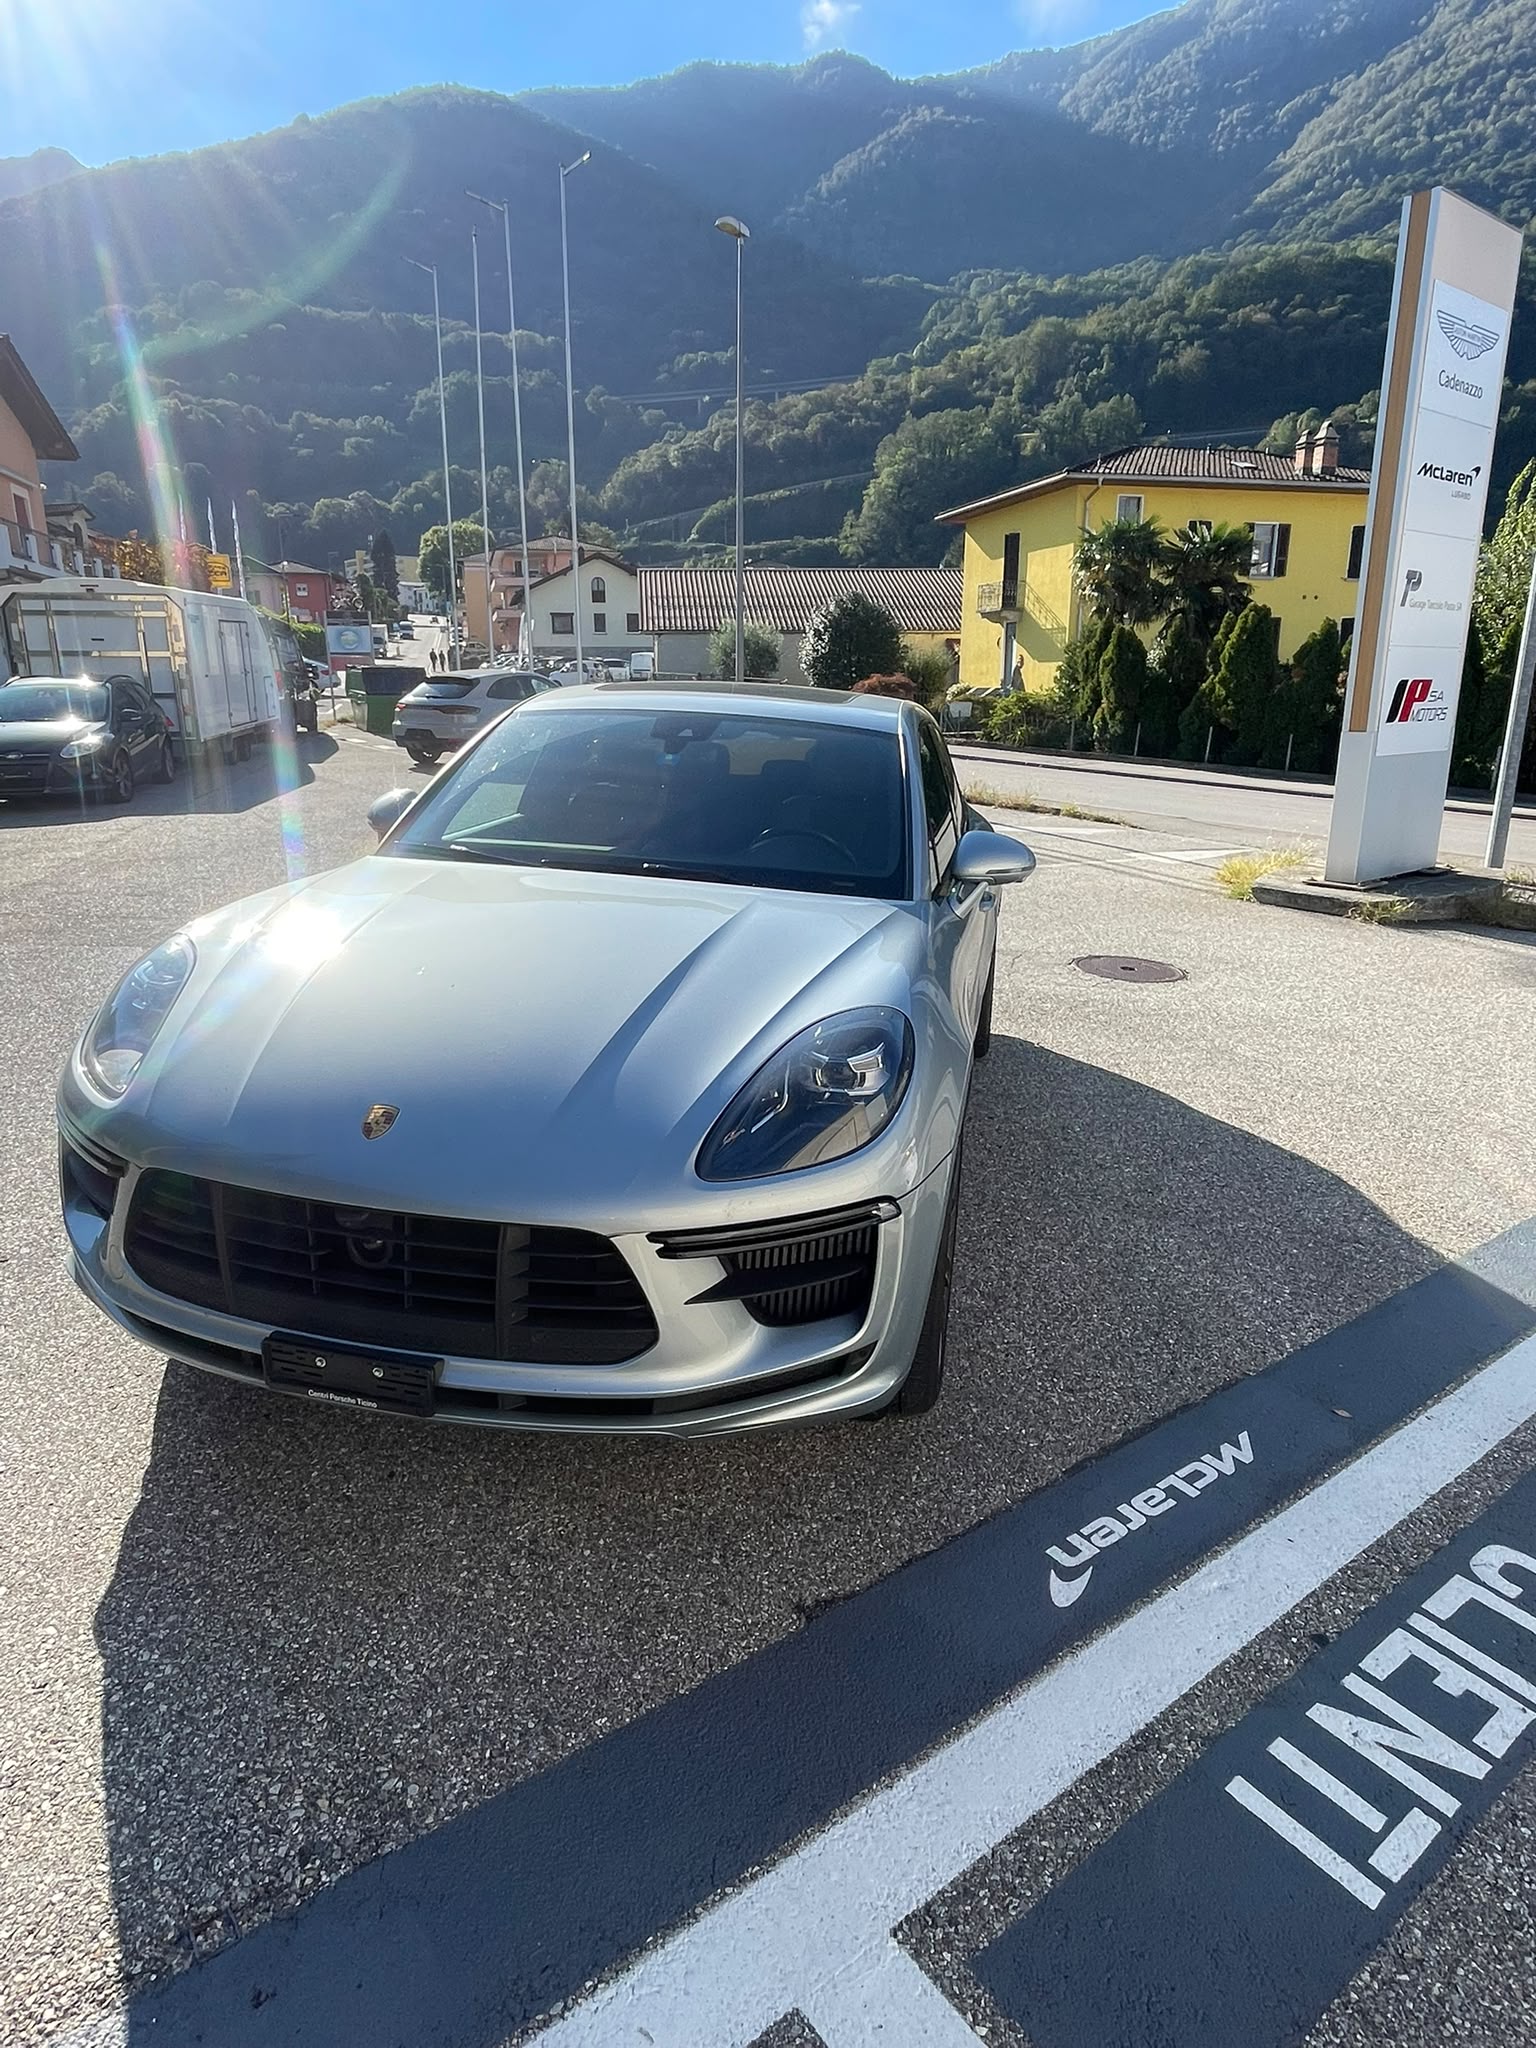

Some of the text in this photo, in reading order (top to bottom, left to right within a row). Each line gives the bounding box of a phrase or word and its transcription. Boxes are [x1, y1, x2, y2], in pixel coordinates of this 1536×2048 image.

[1438, 369, 1483, 399] Cadenazzo
[1417, 462, 1473, 487] McLaren
[1410, 707, 1448, 722] MOTORS
[1045, 1431, 1255, 1567] McLaren
